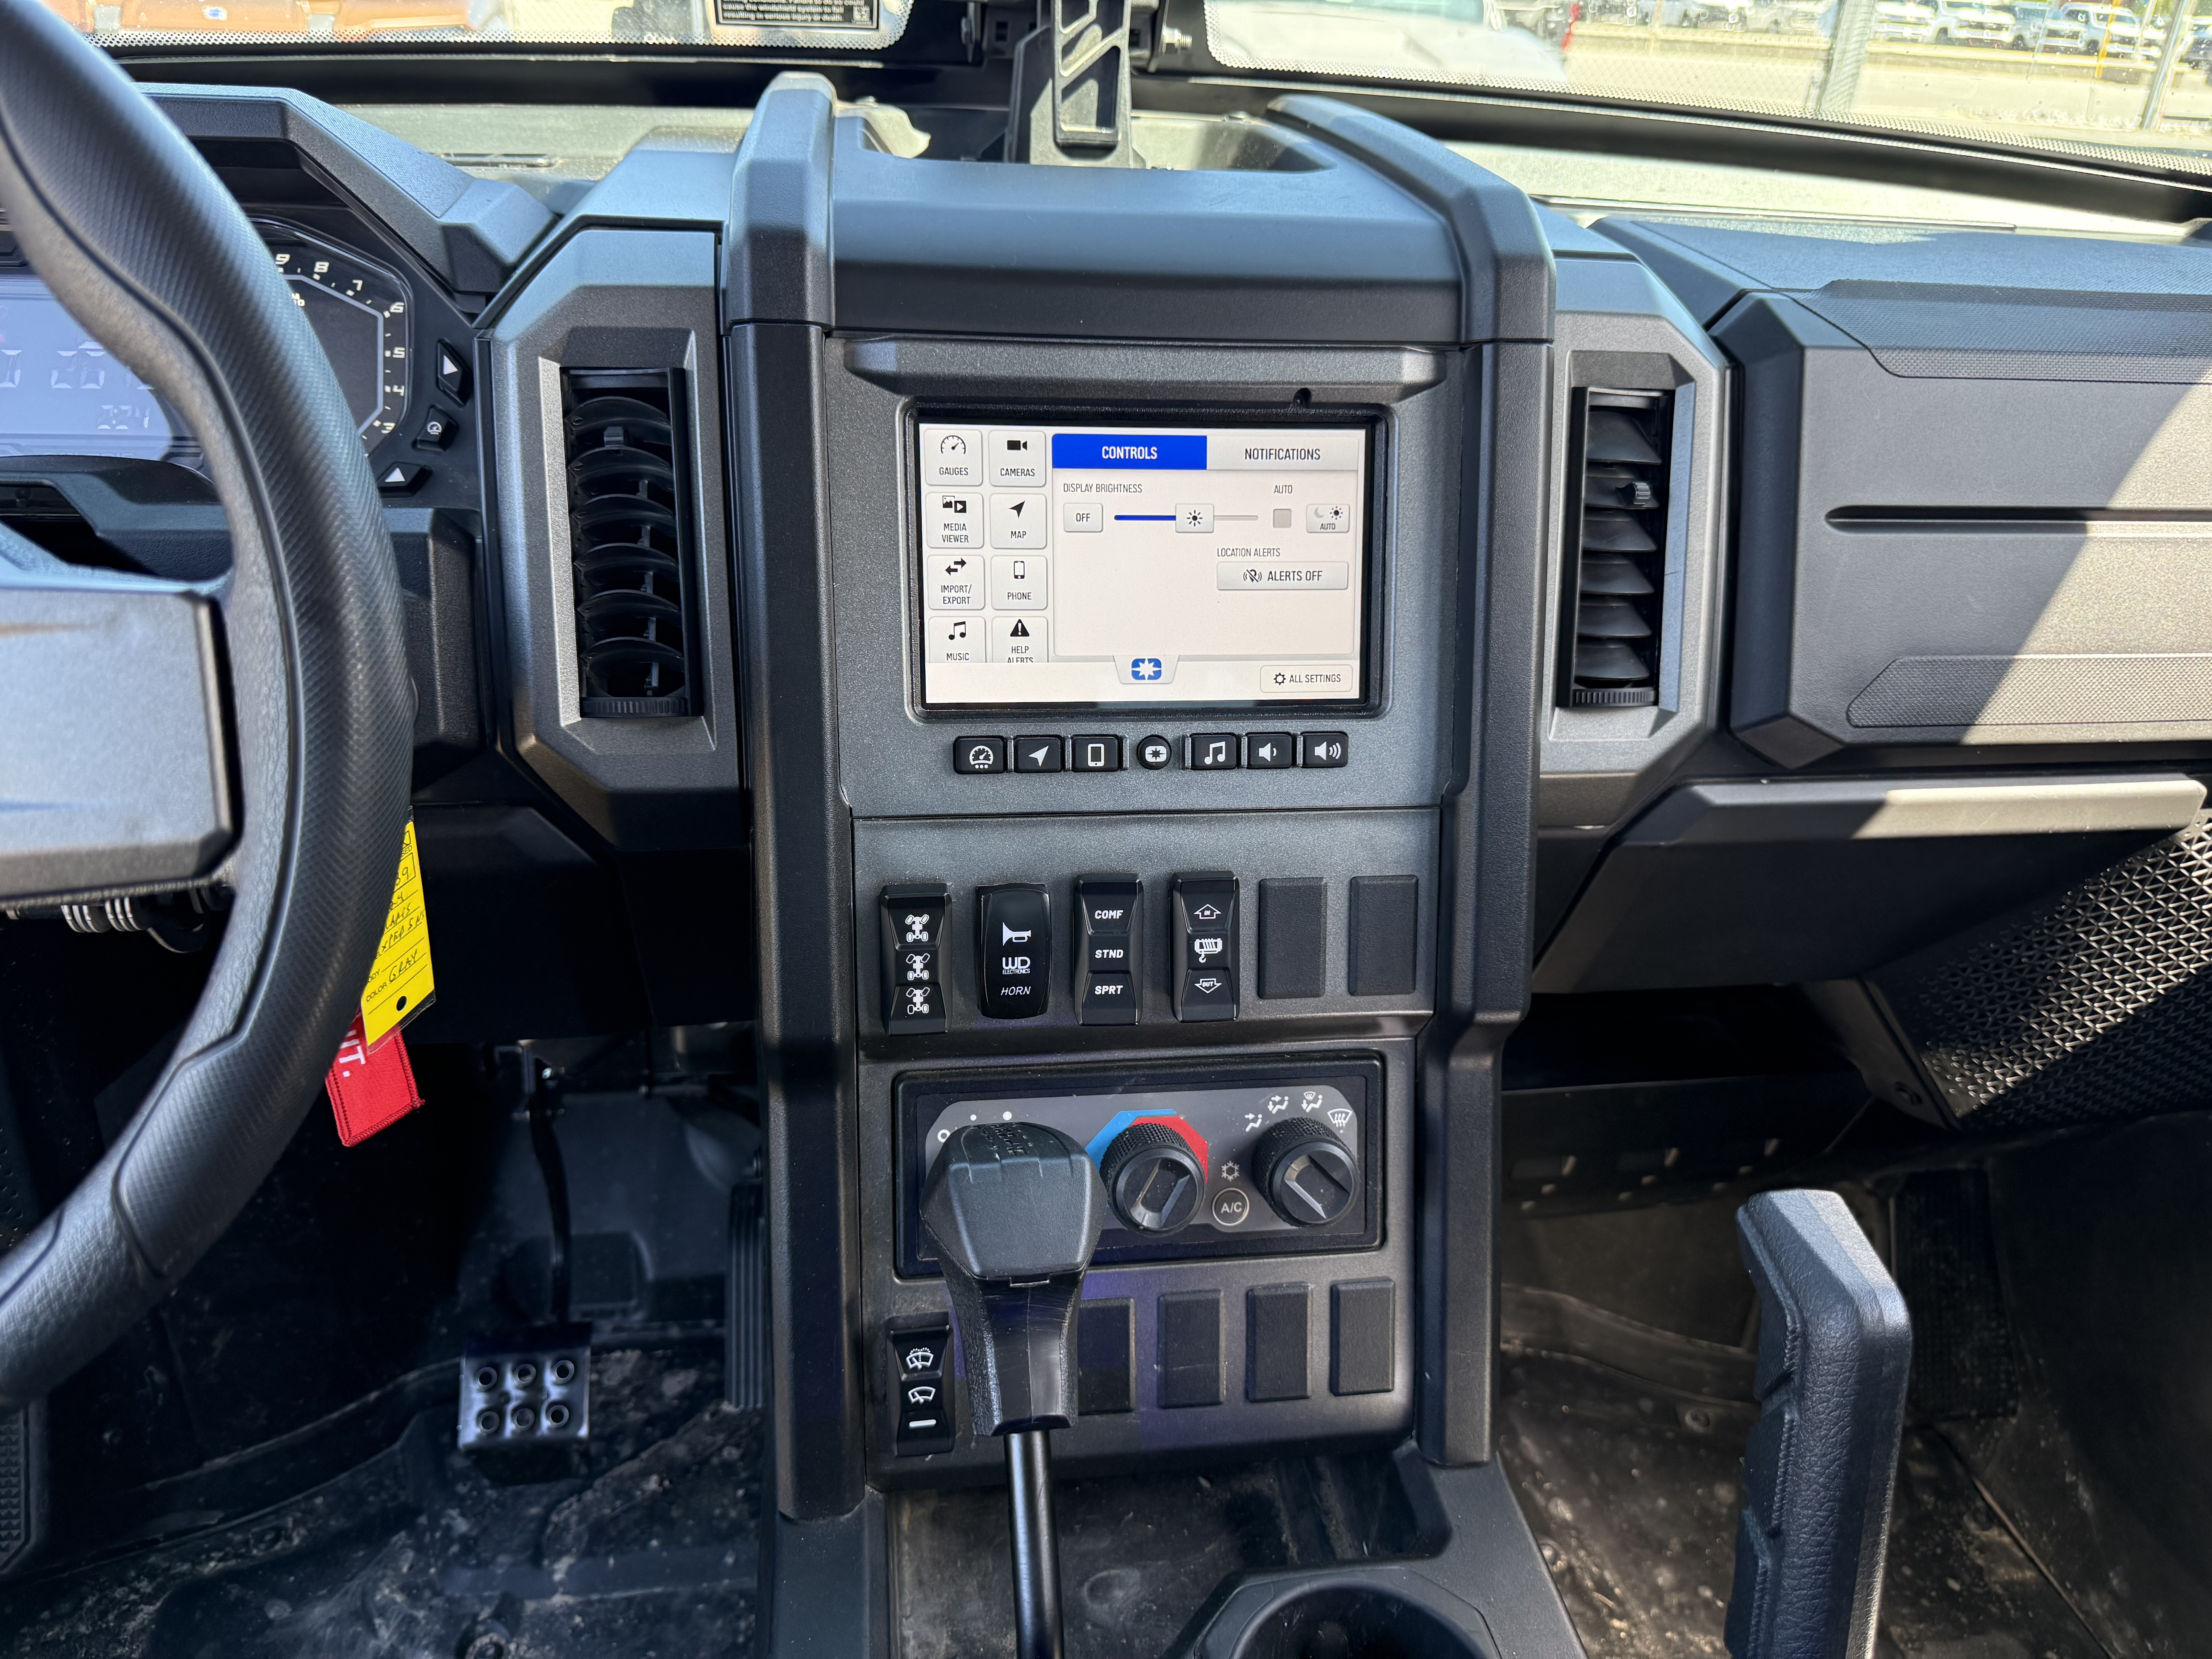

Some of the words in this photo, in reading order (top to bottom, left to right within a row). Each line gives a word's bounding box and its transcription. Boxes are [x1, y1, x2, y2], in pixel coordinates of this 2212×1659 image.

[275, 254, 290, 264] 9
[314, 262, 329, 273] 8
[352, 280, 362, 291] 7
[390, 302, 404, 313] 6
[392, 347, 405, 358] 5
[392, 385, 405, 396] 4
[1102, 446, 1158, 459] CONTROLS
[1245, 448, 1320, 460] NOTIFICATIONS
[939, 467, 968, 476] GAUGES
[1000, 468, 1035, 477] CAMERAS
[1063, 483, 1093, 492] DISPLAY
[1096, 484, 1142, 493] BRIGHTNESS
[1274, 484, 1293, 494] AUTO
[1076, 513, 1091, 522] OFF
[944, 523, 967, 531] MEDIA
[941, 534, 969, 543] VIEWER
[1011, 531, 1027, 539] MAP
[1217, 548, 1251, 557] LOCATION
[1254, 548, 1280, 557] ALERTS
[1267, 570, 1302, 581] ALERTS
[1305, 570, 1322, 581] OFF
[941, 584, 972, 594] IMPORT/
[943, 596, 970, 605] EXPORT
[946, 653, 969, 661] MUSIC
[1289, 674, 1303, 683] ALL
[1305, 674, 1341, 683] SETTINGS
[1094, 910, 1123, 919] COMF
[1095, 949, 1123, 958] STND
[1002, 956, 1031, 970] WD
[368, 969, 380, 983] ODY
[366, 982, 387, 1002] COLOR
[1000, 986, 1031, 996] HORN
[1094, 985, 1123, 994] SPRT
[1221, 1202, 1242, 1213] A/C
